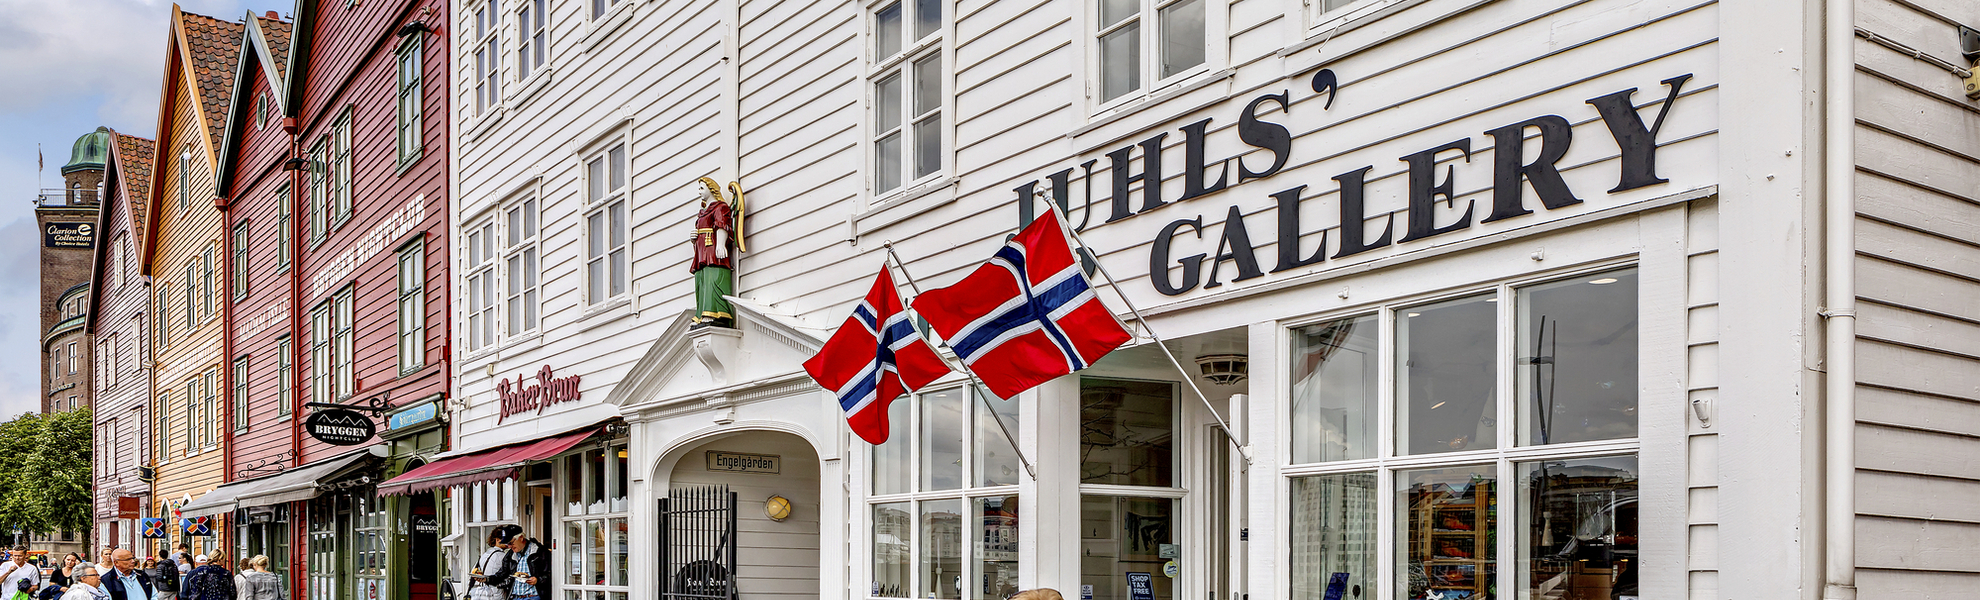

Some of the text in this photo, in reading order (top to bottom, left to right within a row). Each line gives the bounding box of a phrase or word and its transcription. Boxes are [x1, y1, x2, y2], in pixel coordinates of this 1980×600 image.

[1149, 73, 1693, 296] GALLERY
[48, 225, 77, 234] Clarion
[312, 193, 425, 299] BRYGGEN NIGHTCLUB
[315, 424, 368, 437] BRYGGEN
[716, 454, 773, 471] Engelgården
